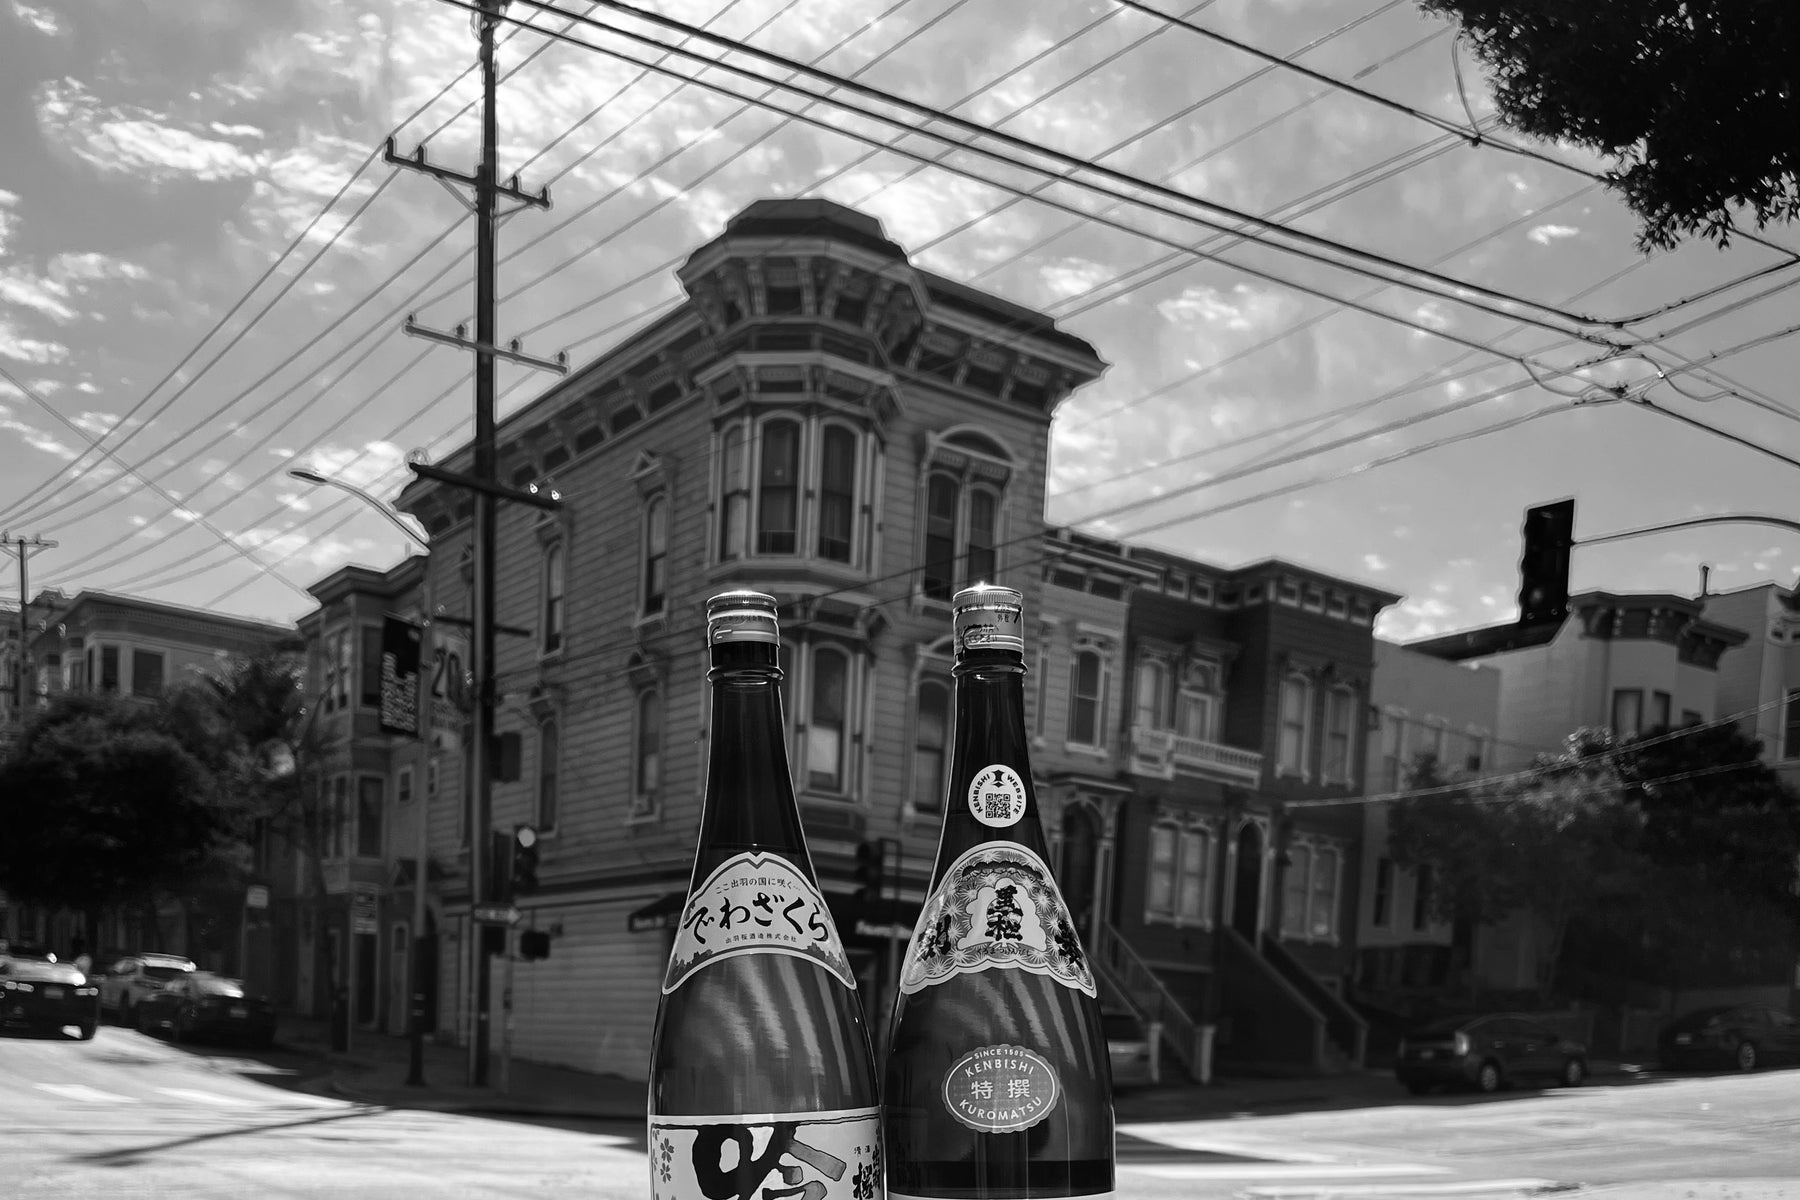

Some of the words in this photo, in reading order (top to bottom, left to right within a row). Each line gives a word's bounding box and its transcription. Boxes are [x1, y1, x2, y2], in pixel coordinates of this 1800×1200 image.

[973, 773, 991, 814] KENBISHI
[1007, 774, 1023, 815] WEBSITE
[683, 892, 829, 944] でわざくら
[974, 1048, 1002, 1060] SINCE
[1004, 1048, 1024, 1057] 1505
[964, 1059, 1034, 1078] KENBISHI
[971, 1079, 1031, 1100] 特撰
[960, 1096, 1042, 1120] KUROMATSU
